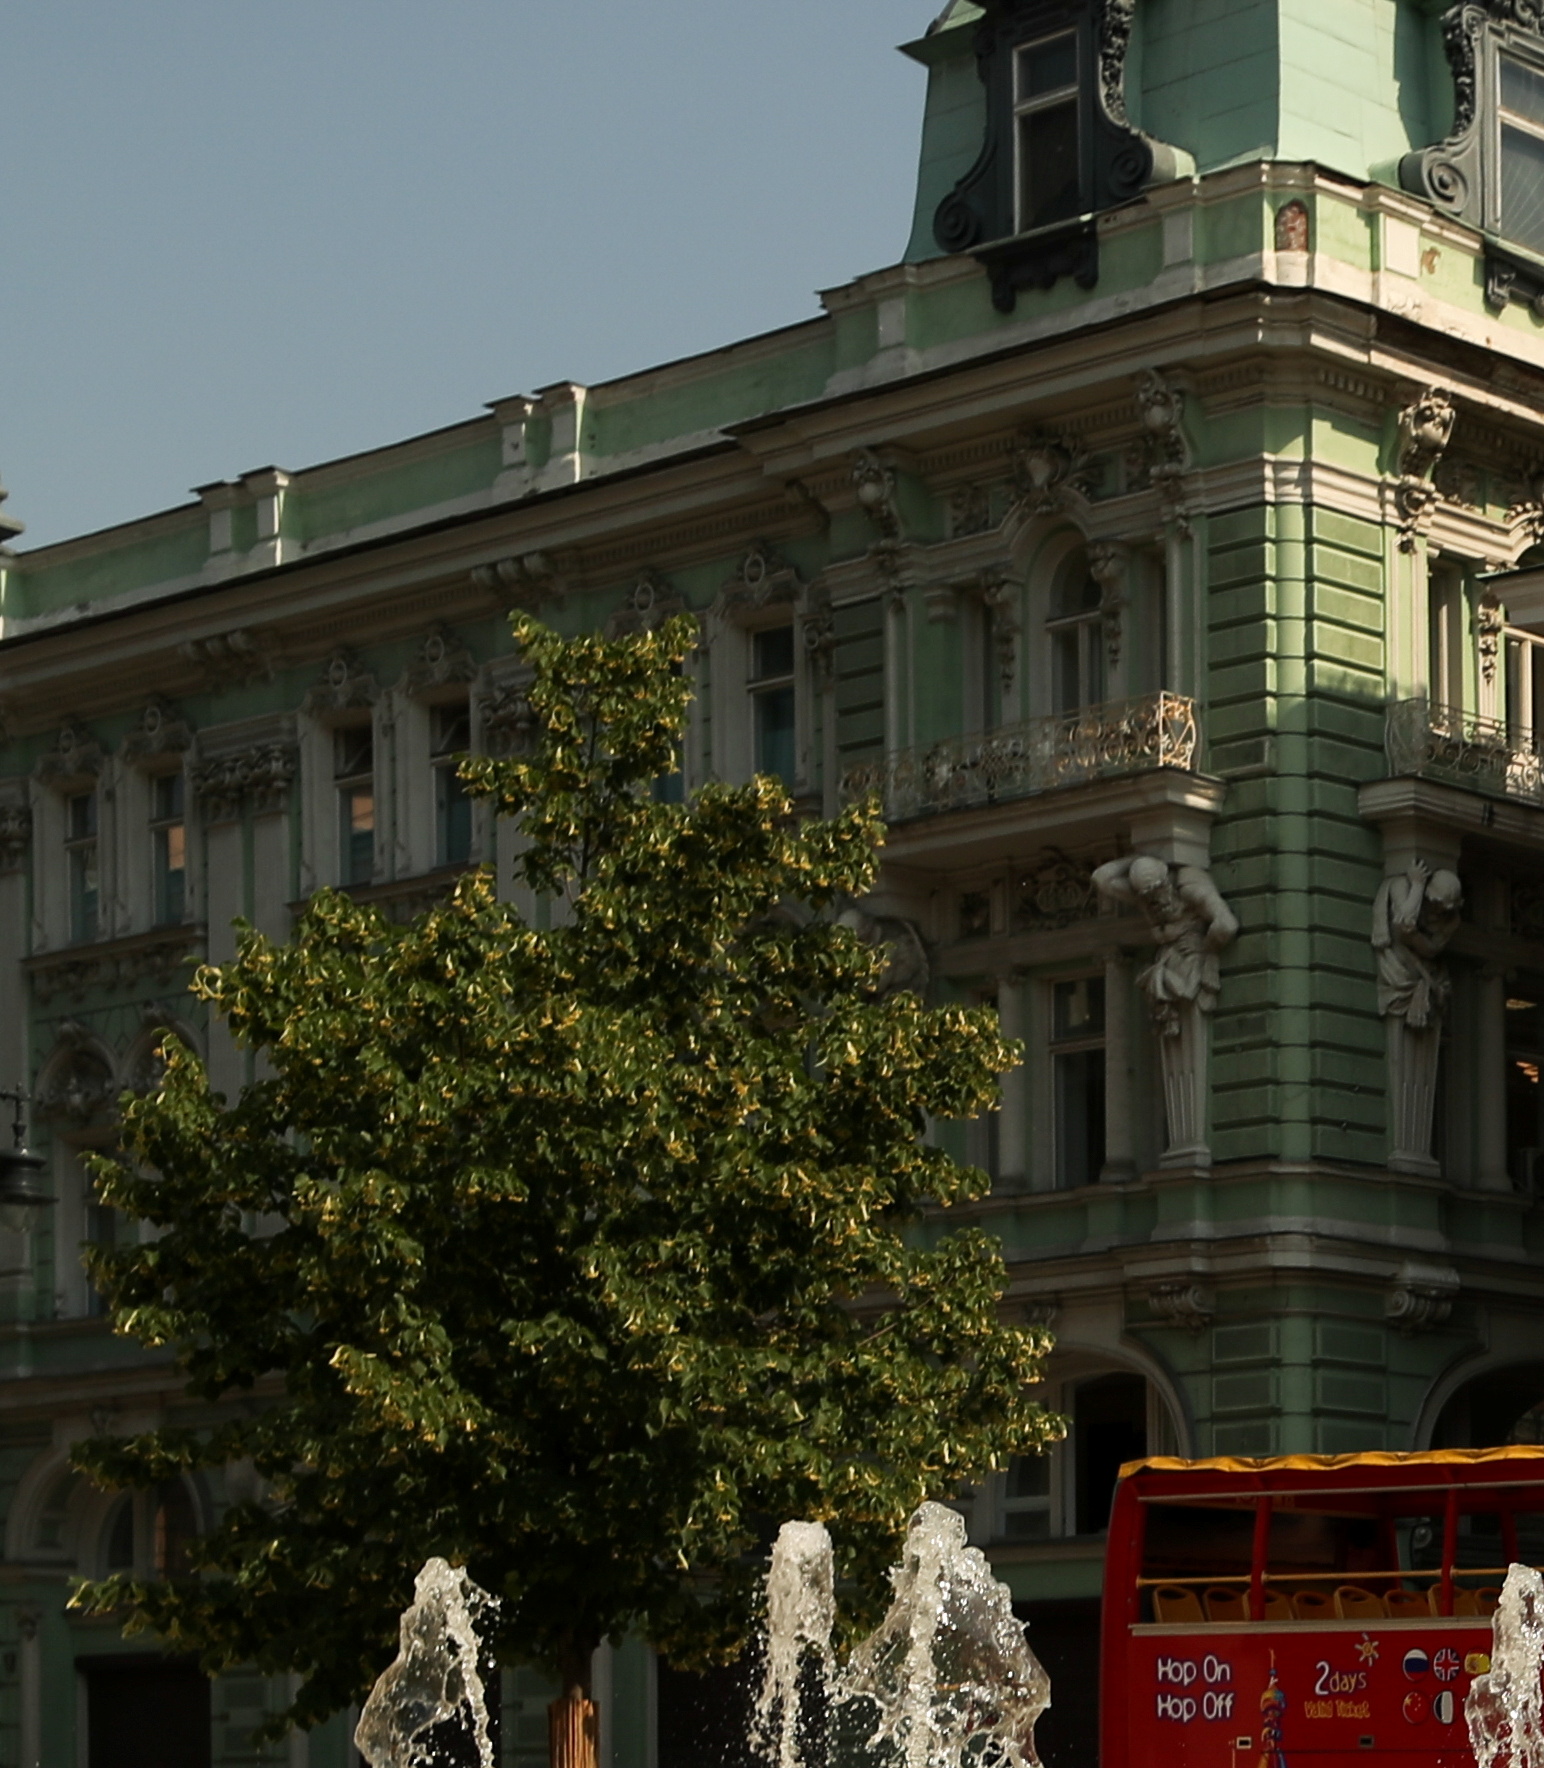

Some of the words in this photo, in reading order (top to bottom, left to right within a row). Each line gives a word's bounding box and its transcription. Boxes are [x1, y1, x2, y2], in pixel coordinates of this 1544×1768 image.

[1157, 1657, 1197, 1687] Hop
[1203, 1655, 1231, 1683] On
[1157, 1693, 1197, 1724] Hop
[1203, 1691, 1235, 1720] Off
